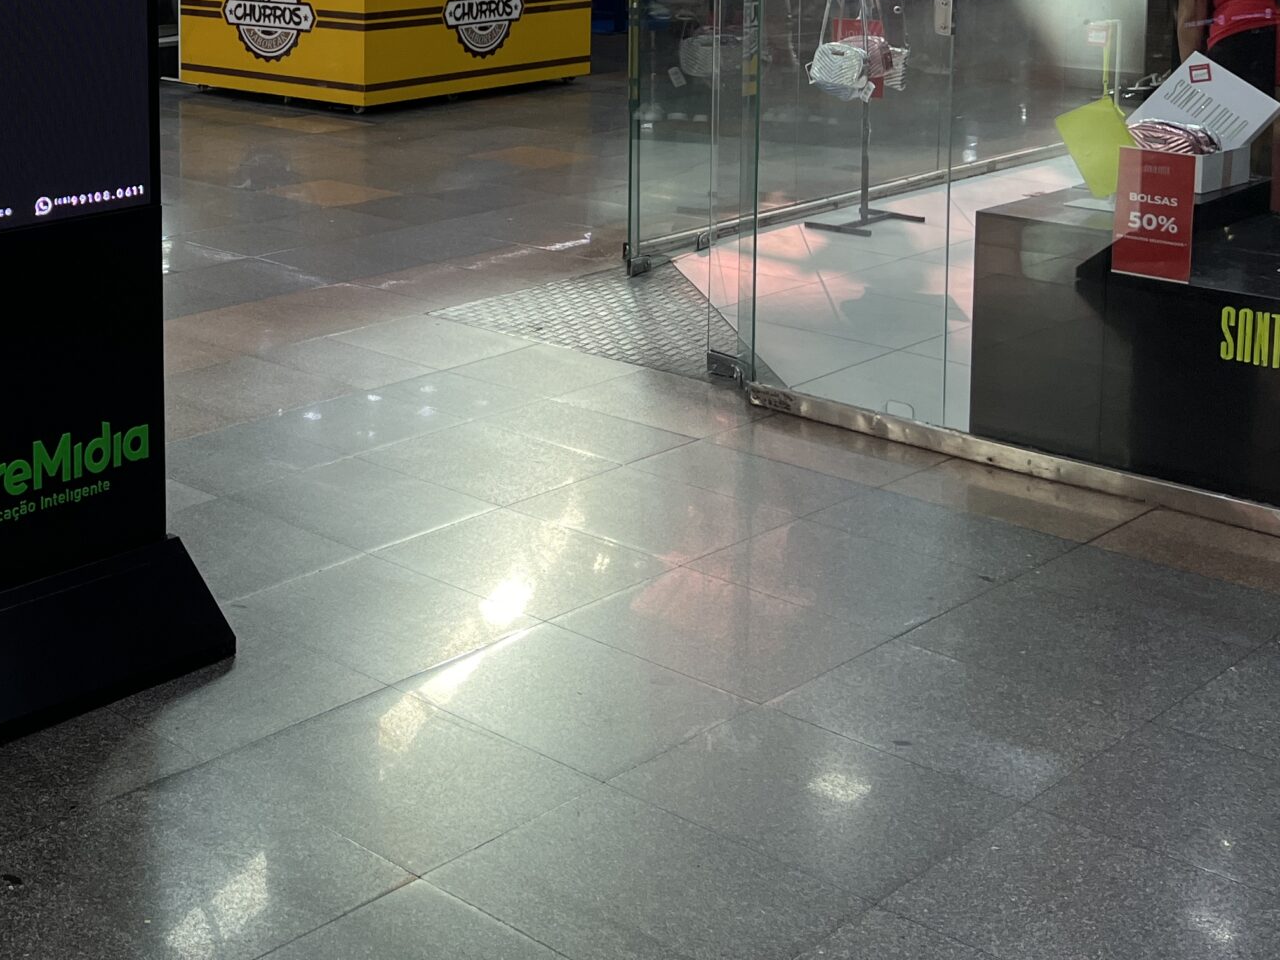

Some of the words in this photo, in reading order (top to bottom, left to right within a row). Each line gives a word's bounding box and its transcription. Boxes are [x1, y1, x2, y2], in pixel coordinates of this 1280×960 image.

[234, 3, 302, 26] CHURROS
[1164, 80, 1213, 118] SANTA
[1129, 192, 1178, 207] BOLSAS
[1128, 211, 1178, 234] 50%
[40, 480, 110, 510] Inteligente
